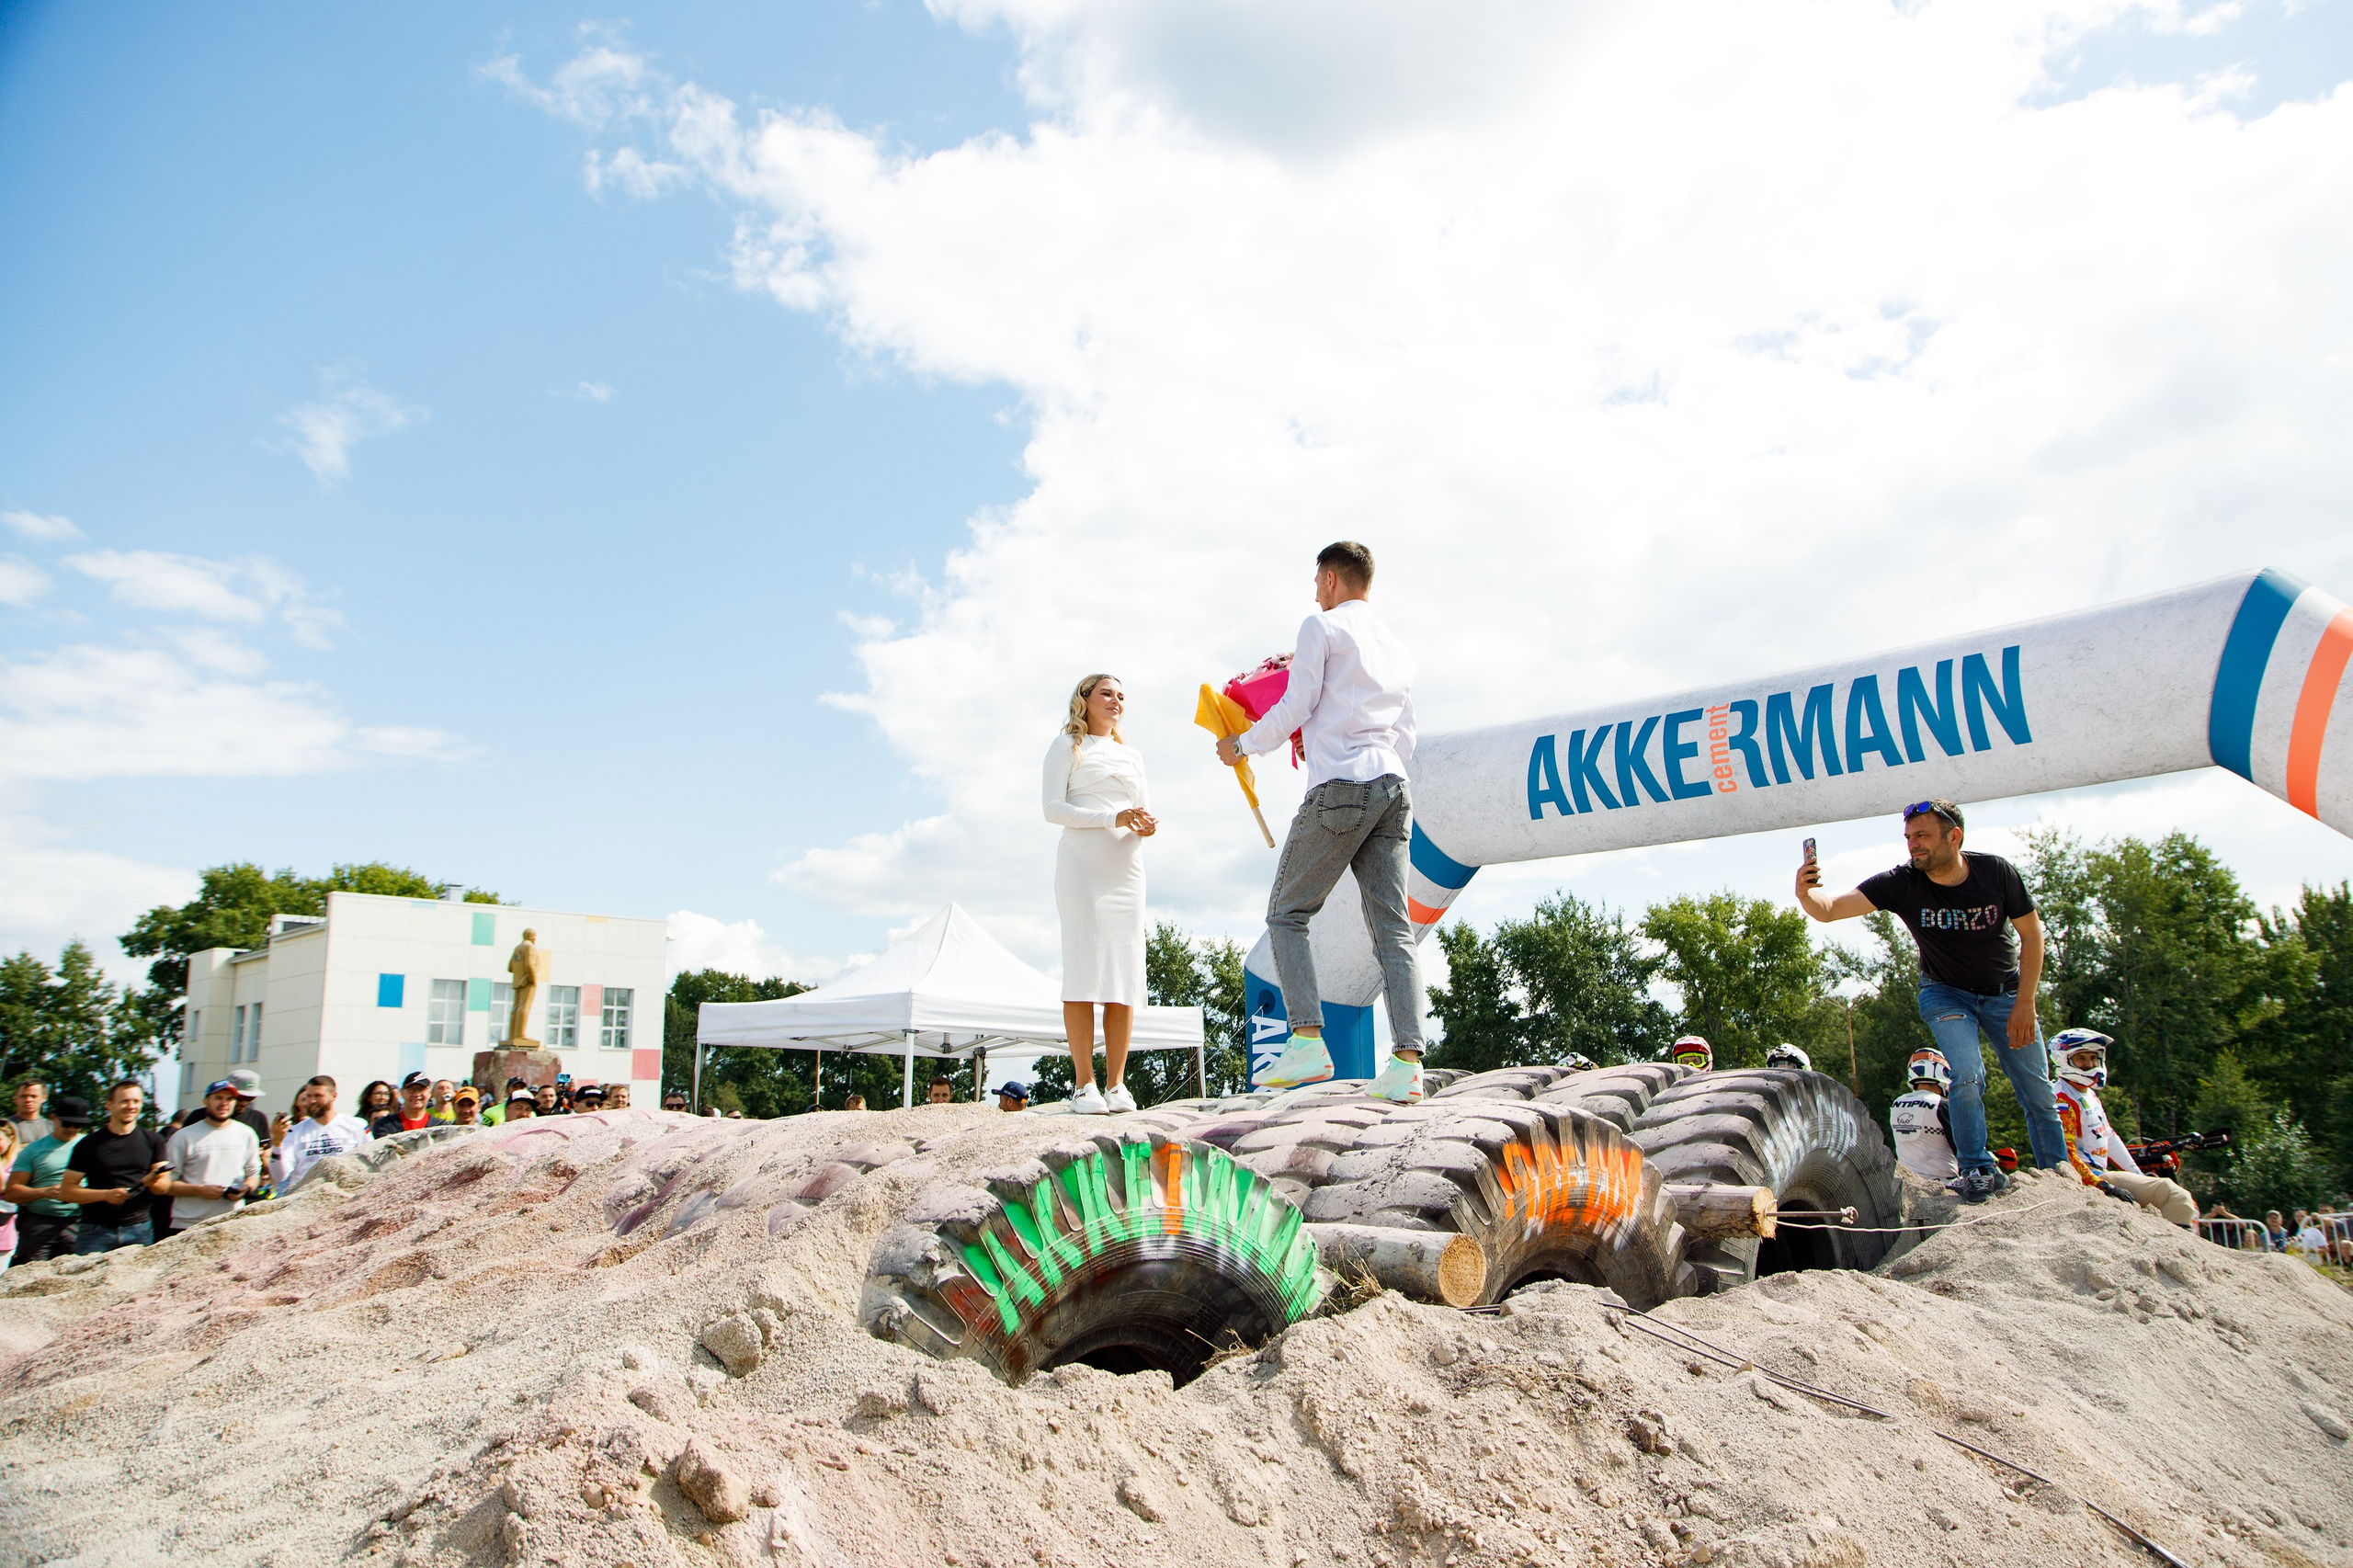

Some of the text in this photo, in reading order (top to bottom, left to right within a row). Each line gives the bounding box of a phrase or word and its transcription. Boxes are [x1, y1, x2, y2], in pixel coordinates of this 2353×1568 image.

[1527, 644, 2032, 821] AKKERMANN
[1705, 702, 1738, 793] cement
[1921, 904, 1998, 931] BORZO
[1893, 1100, 1936, 1110] NTIPIN
